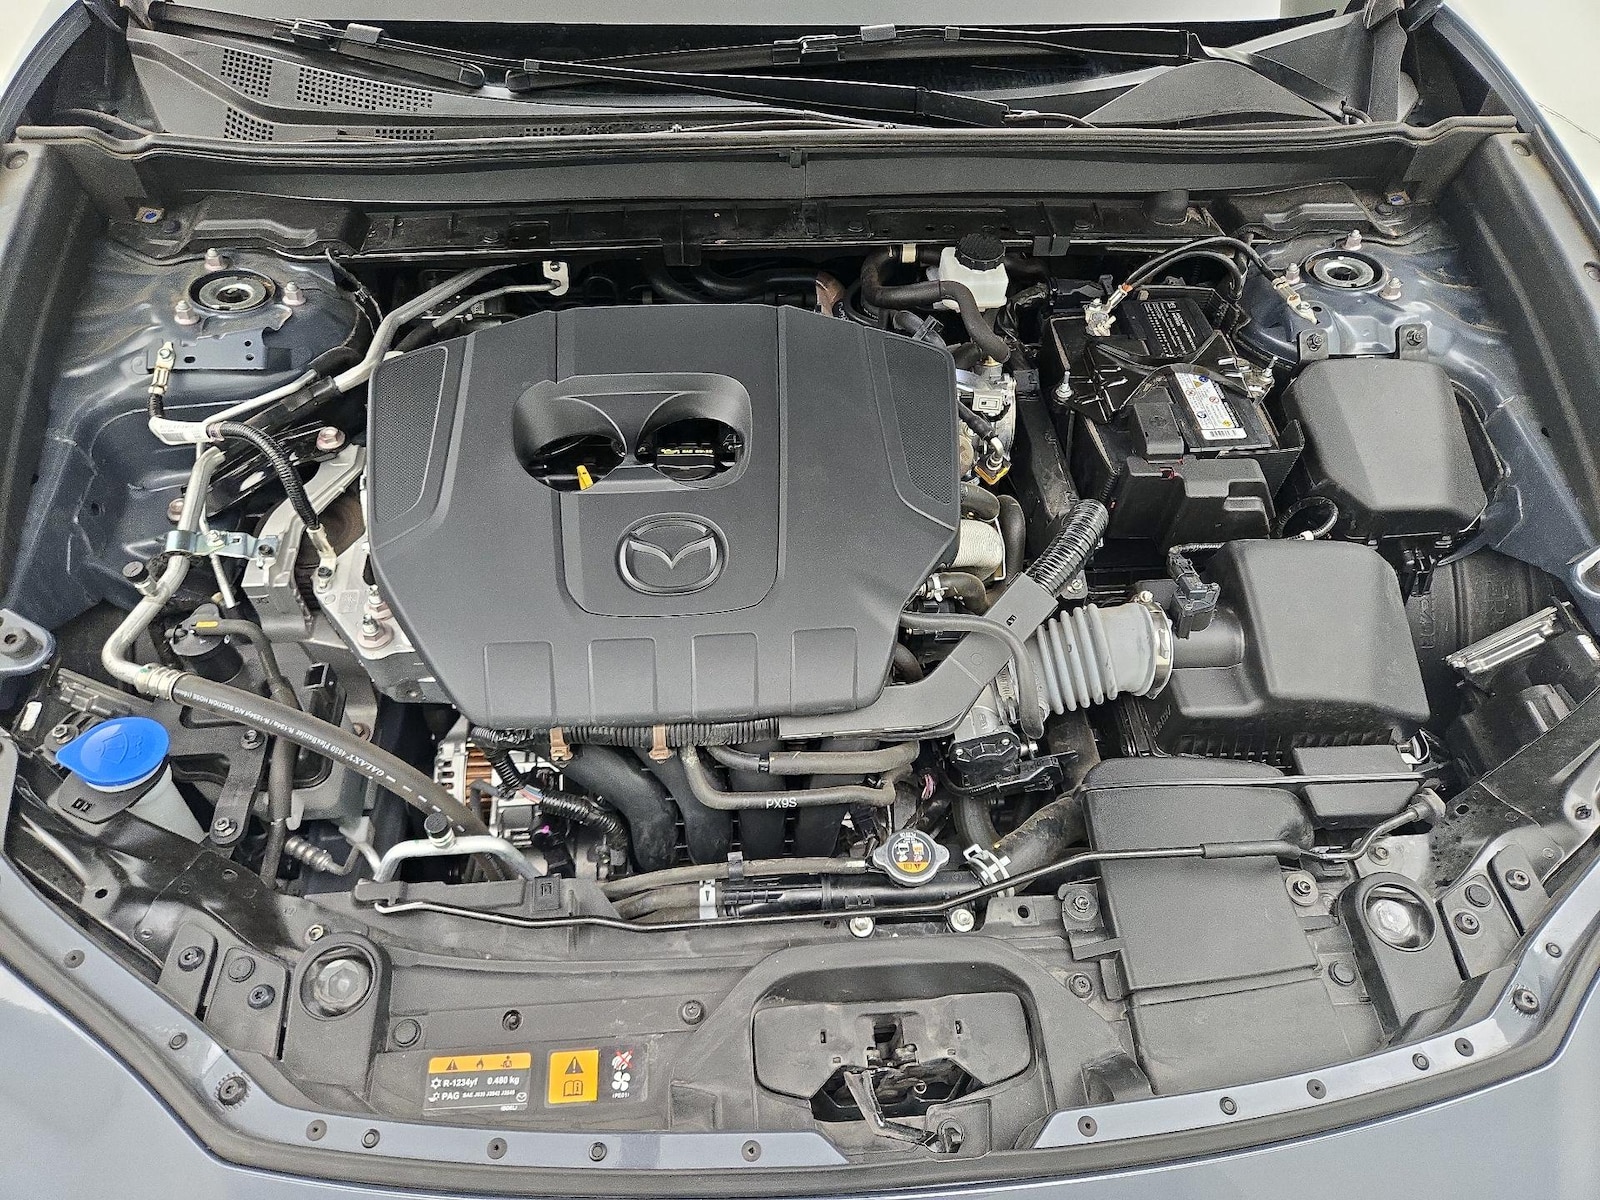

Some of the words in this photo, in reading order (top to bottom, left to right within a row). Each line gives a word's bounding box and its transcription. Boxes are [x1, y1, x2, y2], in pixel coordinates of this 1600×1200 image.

[192, 693, 209, 703] HOSE
[208, 698, 234, 712] SUCTION
[346, 753, 385, 777] GALAXY
[766, 797, 797, 809] PX9S
[443, 1077, 478, 1088] R-1234yf
[487, 1076, 508, 1085] 0.480
[509, 1076, 520, 1085] kg
[441, 1092, 460, 1100] PAG
